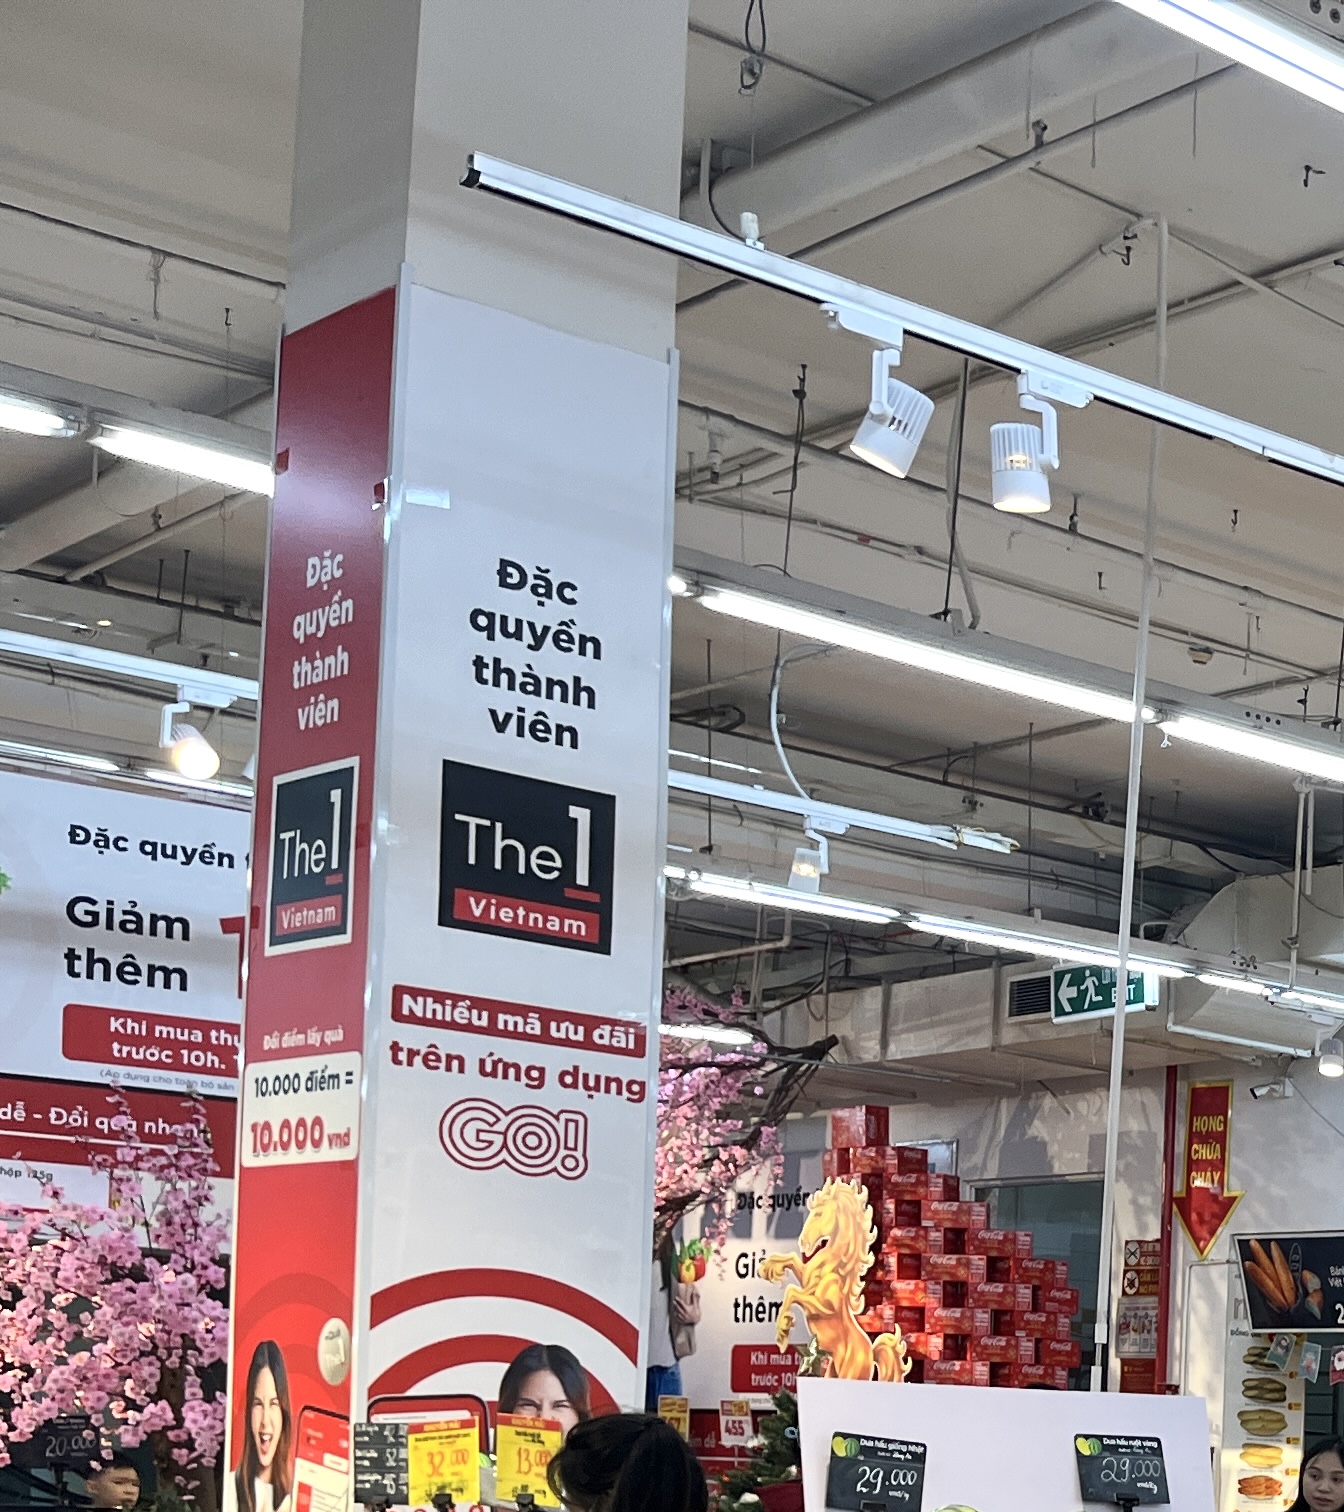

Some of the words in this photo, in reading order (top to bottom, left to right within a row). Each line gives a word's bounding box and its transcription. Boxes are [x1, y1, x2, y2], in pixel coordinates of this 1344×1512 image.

[305, 550, 343, 590] Đặc
[496, 559, 578, 608] Đặc
[293, 596, 354, 641] quyền
[469, 604, 602, 660] quyền
[293, 649, 349, 689] thành
[472, 654, 597, 710] thành
[298, 696, 340, 730] viên
[489, 707, 578, 750] viên
[68, 823, 128, 855] Đặc
[139, 838, 235, 869] quyền
[66, 894, 191, 942] Giảm
[280, 903, 336, 930] Vietnam
[469, 897, 587, 936] Vietnam
[64, 946, 188, 993] thêm
[110, 1016, 147, 1037] Khi
[155, 1024, 203, 1043] mua
[402, 994, 488, 1027] Nhiều
[498, 1012, 541, 1036] mã
[550, 1022, 584, 1042] ưu
[592, 1025, 635, 1050] đãi
[112, 1040, 173, 1065] trước
[389, 1040, 465, 1074] trên
[479, 1052, 546, 1089] ứng
[558, 1065, 646, 1103] dụng
[254, 1072, 301, 1098] 10.000
[305, 1065, 341, 1092] điểm
[49, 1104, 88, 1128] Đổi
[1193, 1115, 1224, 1134] HỌNG
[251, 1116, 325, 1157] 10.000
[328, 1126, 351, 1149] vnd
[439, 1097, 588, 1180] GO!
[1191, 1139, 1221, 1160] CHỮA
[1190, 1167, 1221, 1188] CHÁY
[724, 1418, 745, 1436] 455
[856, 1466, 917, 1493] 29.000
[1100, 1457, 1161, 1483] 29.000
